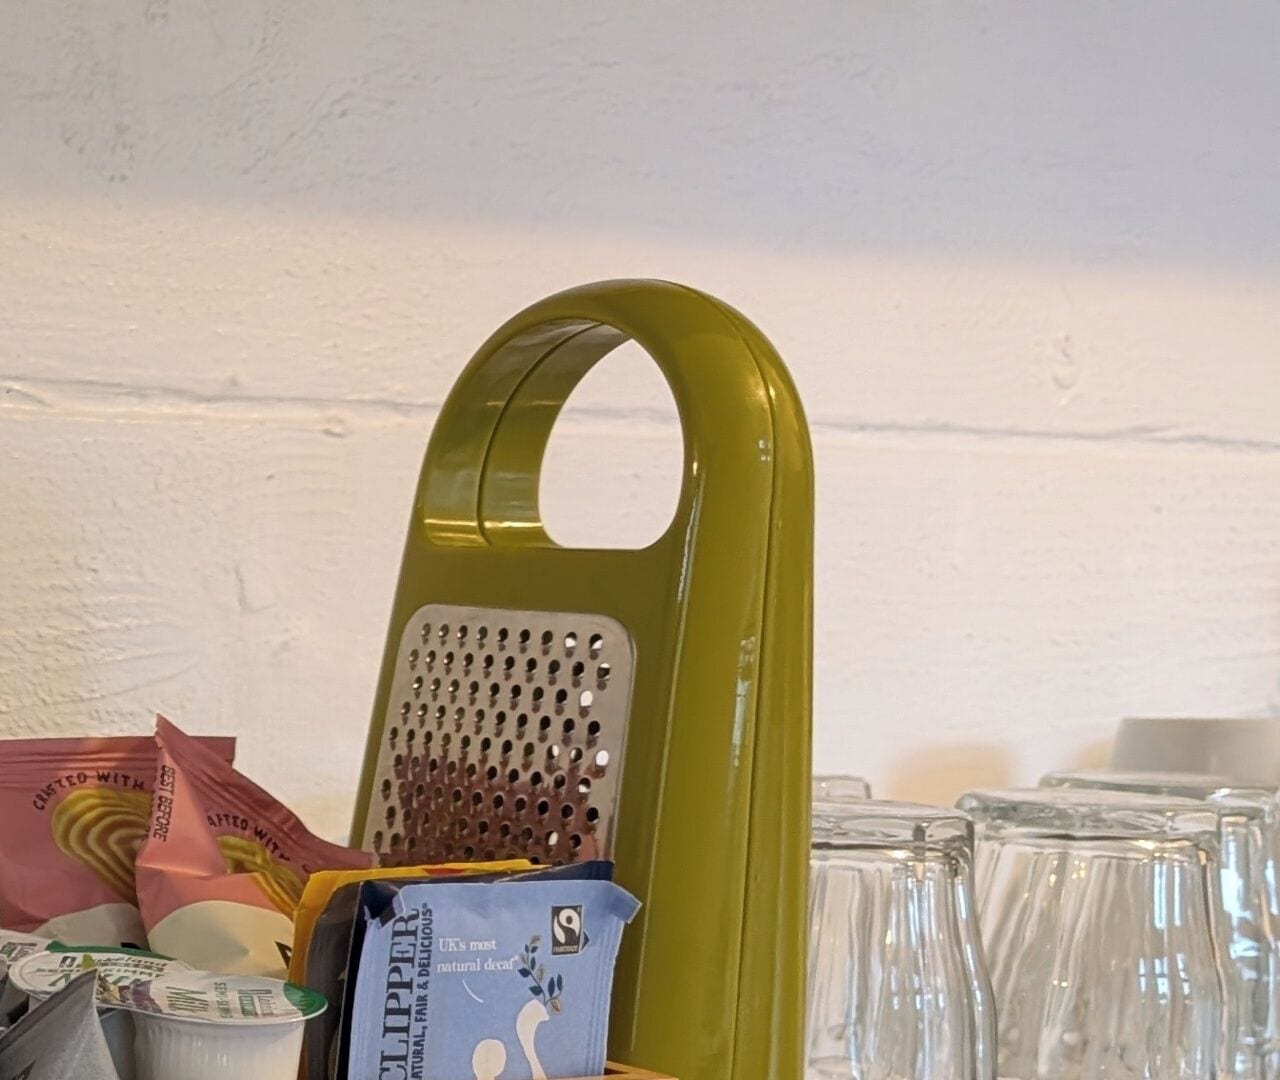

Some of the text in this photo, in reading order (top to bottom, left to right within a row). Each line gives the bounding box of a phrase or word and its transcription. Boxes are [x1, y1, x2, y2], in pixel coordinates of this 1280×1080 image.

[32, 769, 145, 811] CRAFTED WITH
[152, 764, 176, 842] BEST BEFORE
[207, 812, 249, 830] AFTED
[439, 937, 497, 952] UK's most
[436, 958, 481, 973] natural
[416, 980, 430, 990] &
[415, 993, 429, 1024] FAIR
